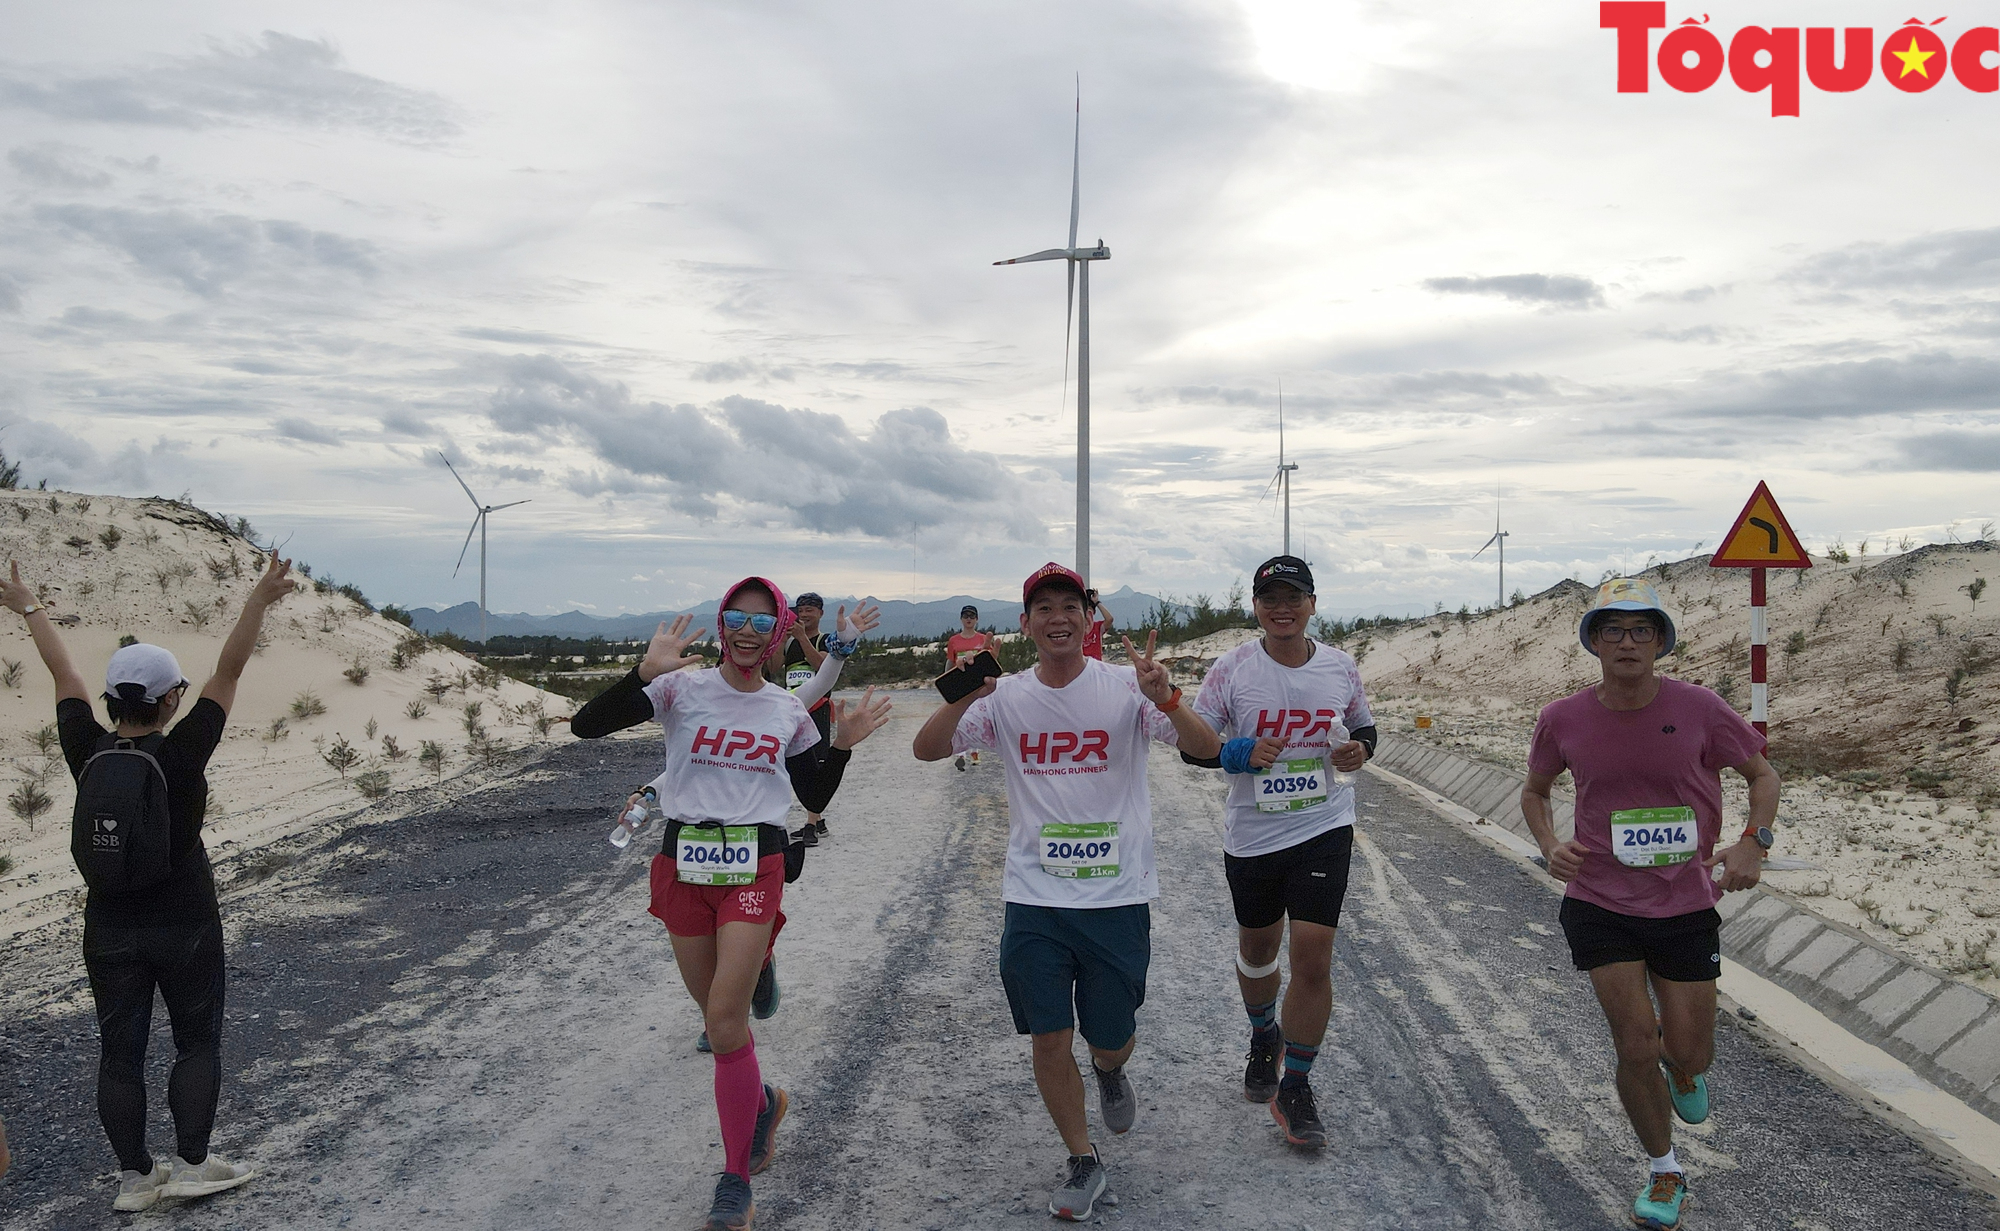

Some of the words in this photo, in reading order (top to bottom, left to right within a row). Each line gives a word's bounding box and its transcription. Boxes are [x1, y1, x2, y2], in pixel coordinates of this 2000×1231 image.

[788, 671, 812, 680] 20070
[1256, 709, 1336, 738] HPR
[690, 726, 781, 765] HPR
[1020, 730, 1110, 764] HPR
[708, 760, 737, 770] PHONG
[738, 764, 776, 776] RUNNERS
[1068, 764, 1108, 775] RUNNERS
[1262, 775, 1318, 794] 20396
[92, 834, 120, 847] SSB
[1623, 827, 1687, 846] 20414
[683, 845, 750, 864] 20400
[1047, 841, 1112, 859] 20409
[738, 891, 766, 906] GIRLS
